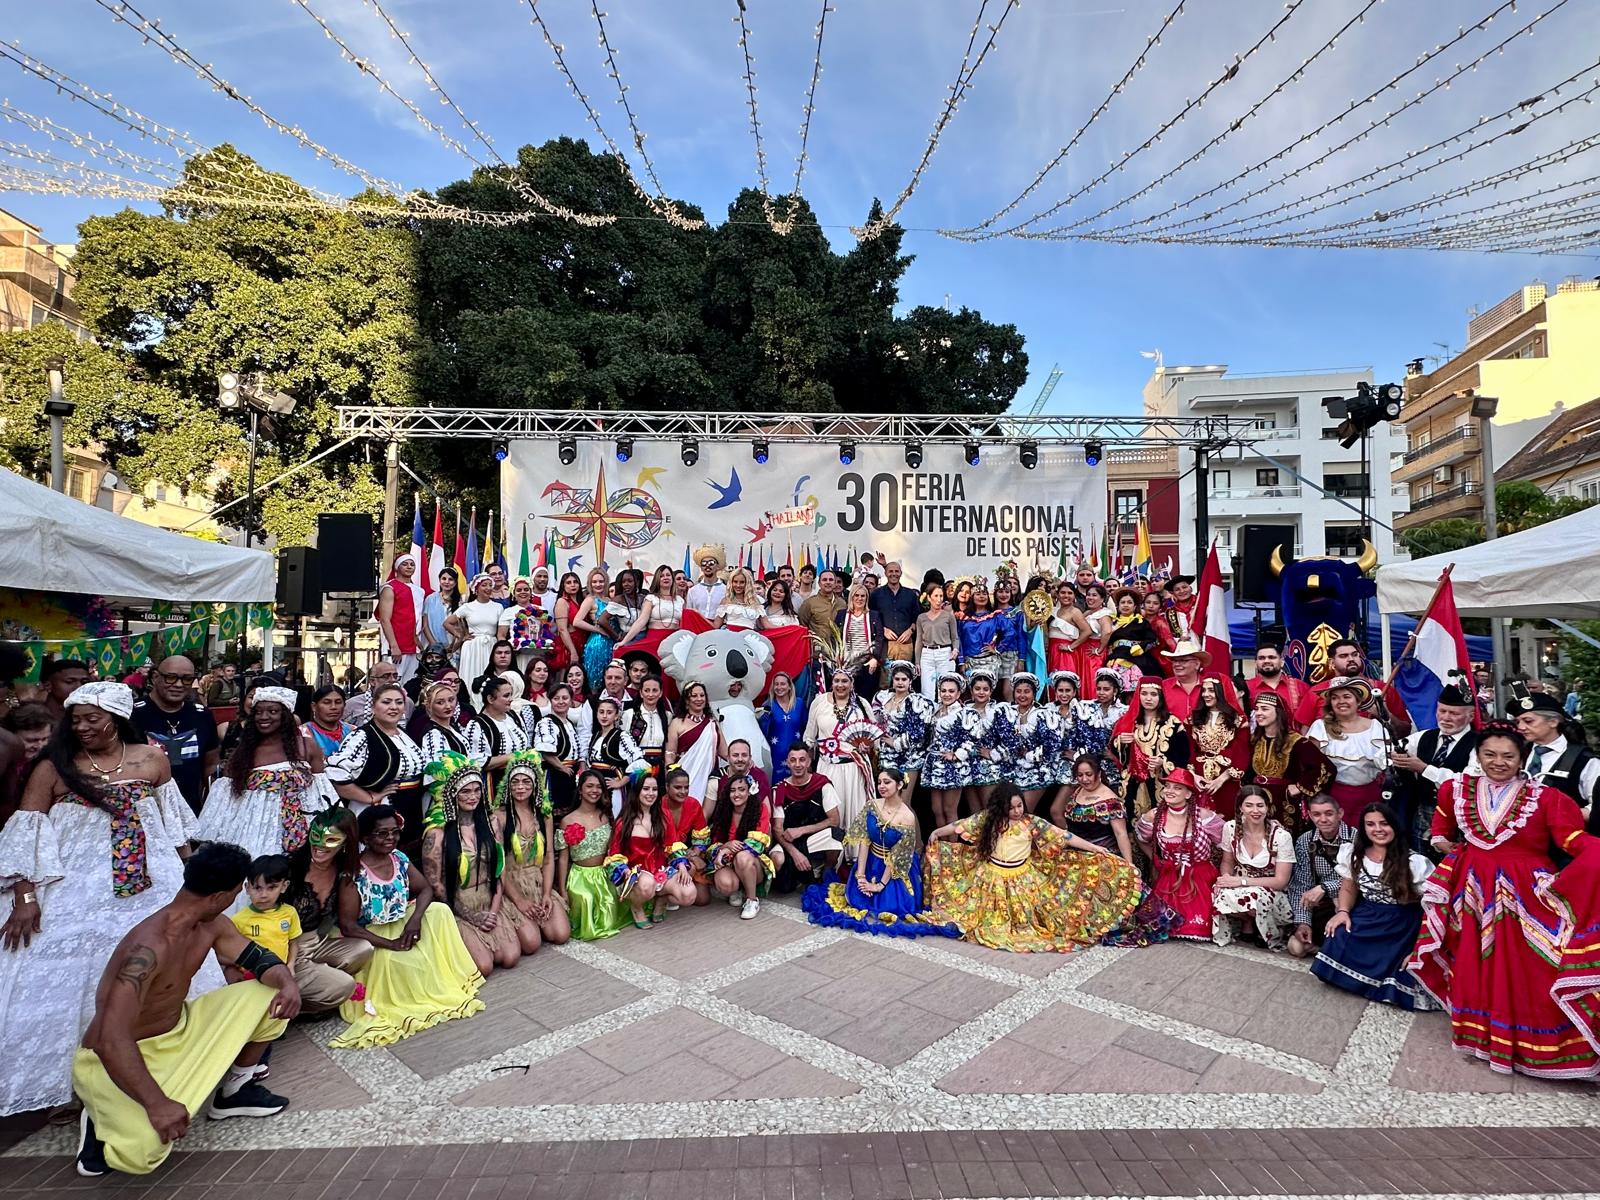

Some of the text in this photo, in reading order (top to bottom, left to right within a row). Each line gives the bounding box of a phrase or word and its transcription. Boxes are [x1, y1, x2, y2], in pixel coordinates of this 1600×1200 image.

[902, 473, 965, 500] FERIA
[838, 472, 899, 531] 30
[665, 515, 672, 524] E
[902, 505, 1080, 533] INTERNACIONAL
[967, 533, 1080, 557] DE LOS PAÍSES
[251, 924, 260, 937] 10
